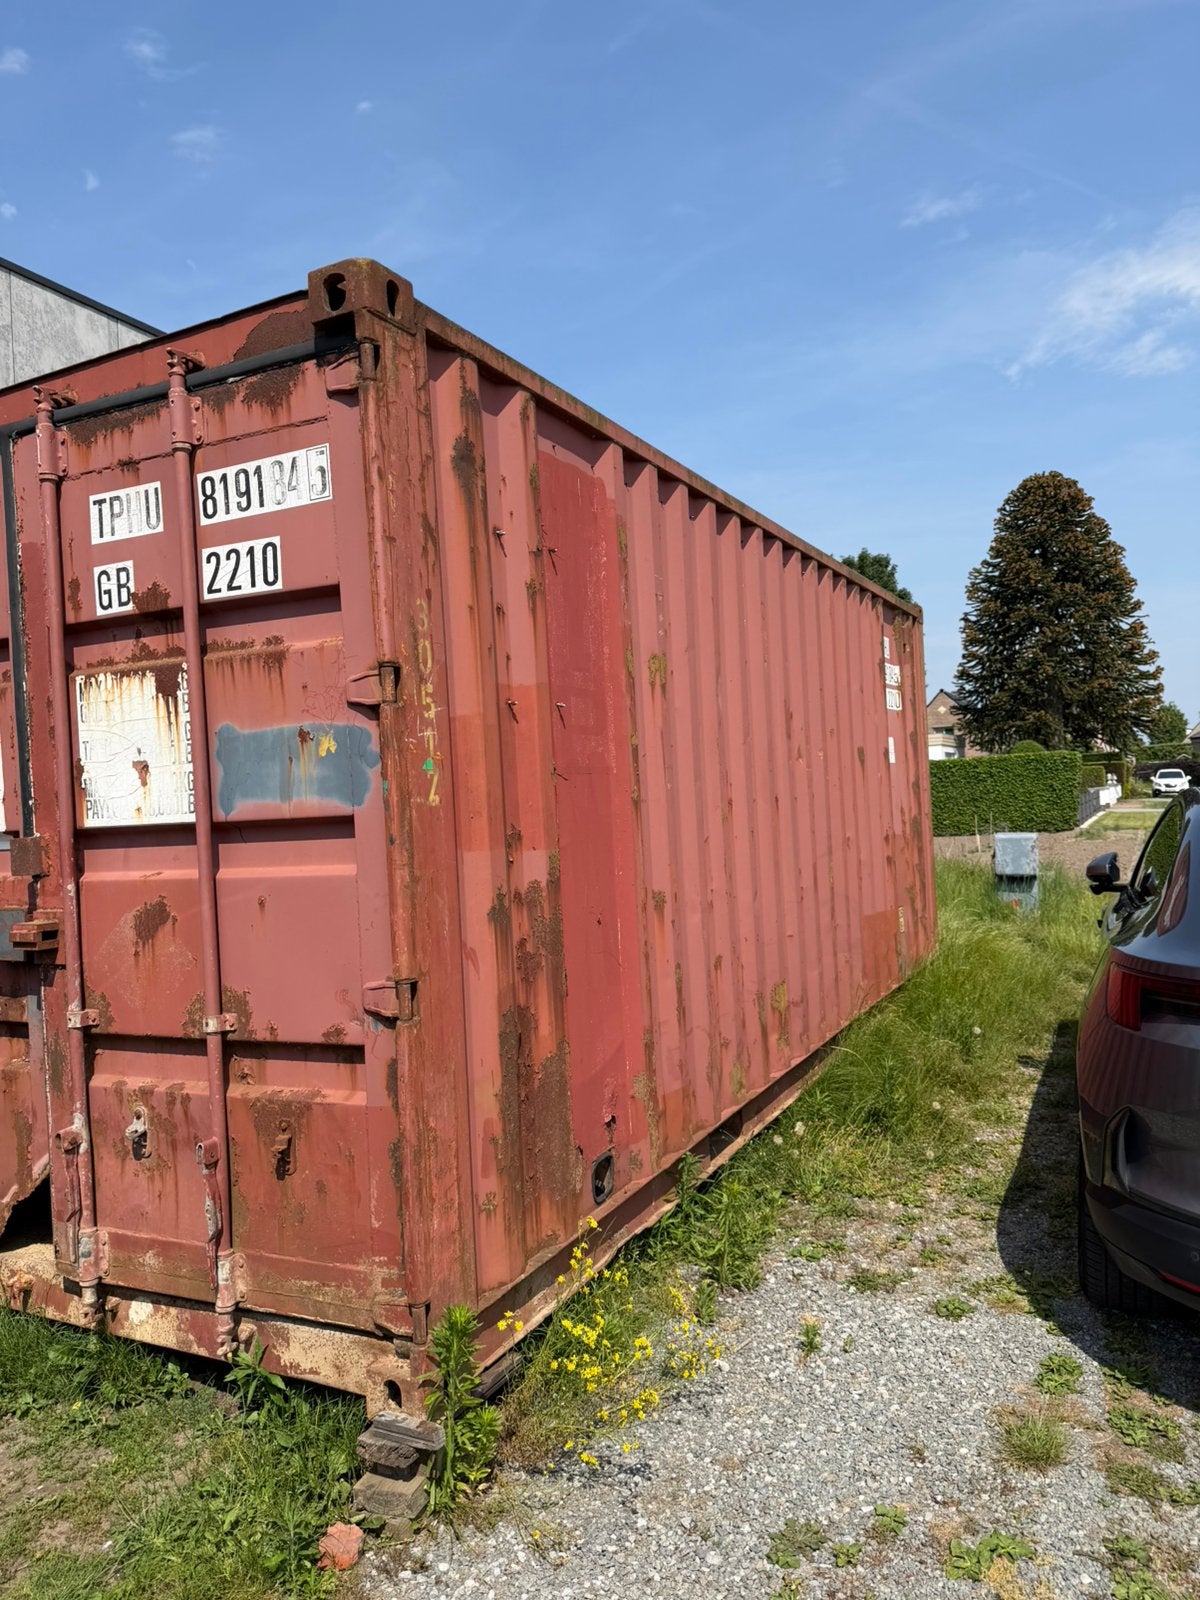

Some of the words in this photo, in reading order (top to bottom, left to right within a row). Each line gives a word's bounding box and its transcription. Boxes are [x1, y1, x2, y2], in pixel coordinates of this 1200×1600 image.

[92, 486, 161, 539] TPHU
[97, 566, 131, 611] GB
[205, 541, 279, 595] 2210
